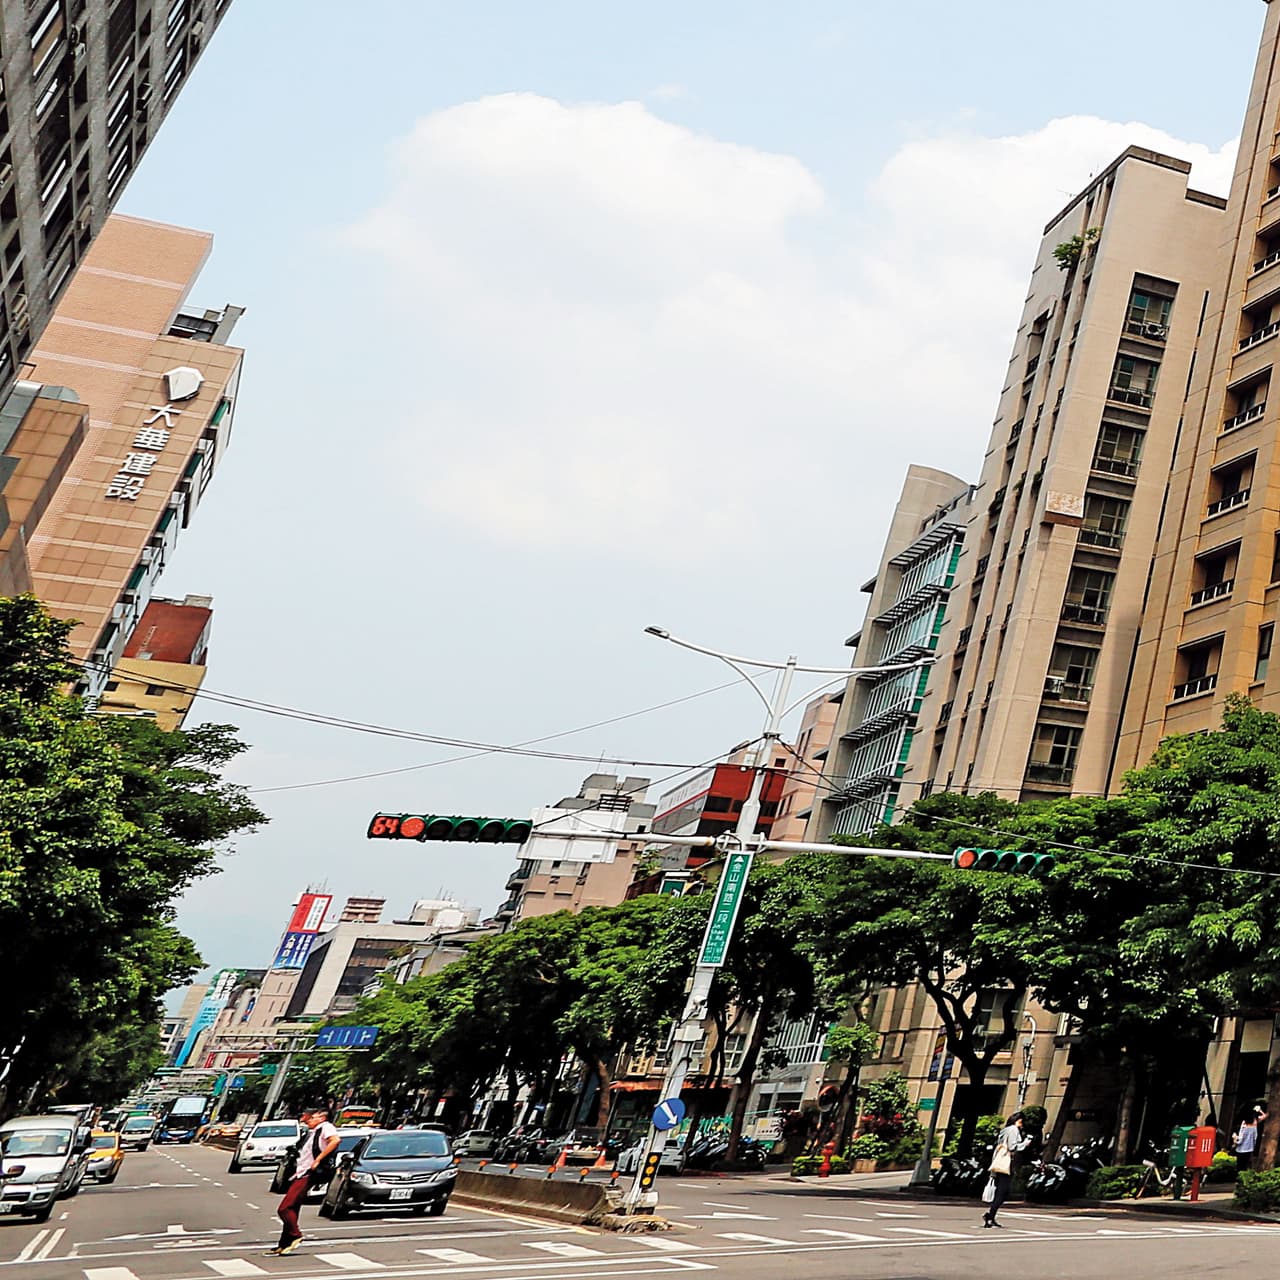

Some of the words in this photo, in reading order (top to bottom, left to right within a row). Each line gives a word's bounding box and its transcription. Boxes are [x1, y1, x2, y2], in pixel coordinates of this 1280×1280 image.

[104, 404, 182, 501] 大華建設
[371, 816, 400, 835] 64
[717, 862, 743, 924] 金山南路二段
